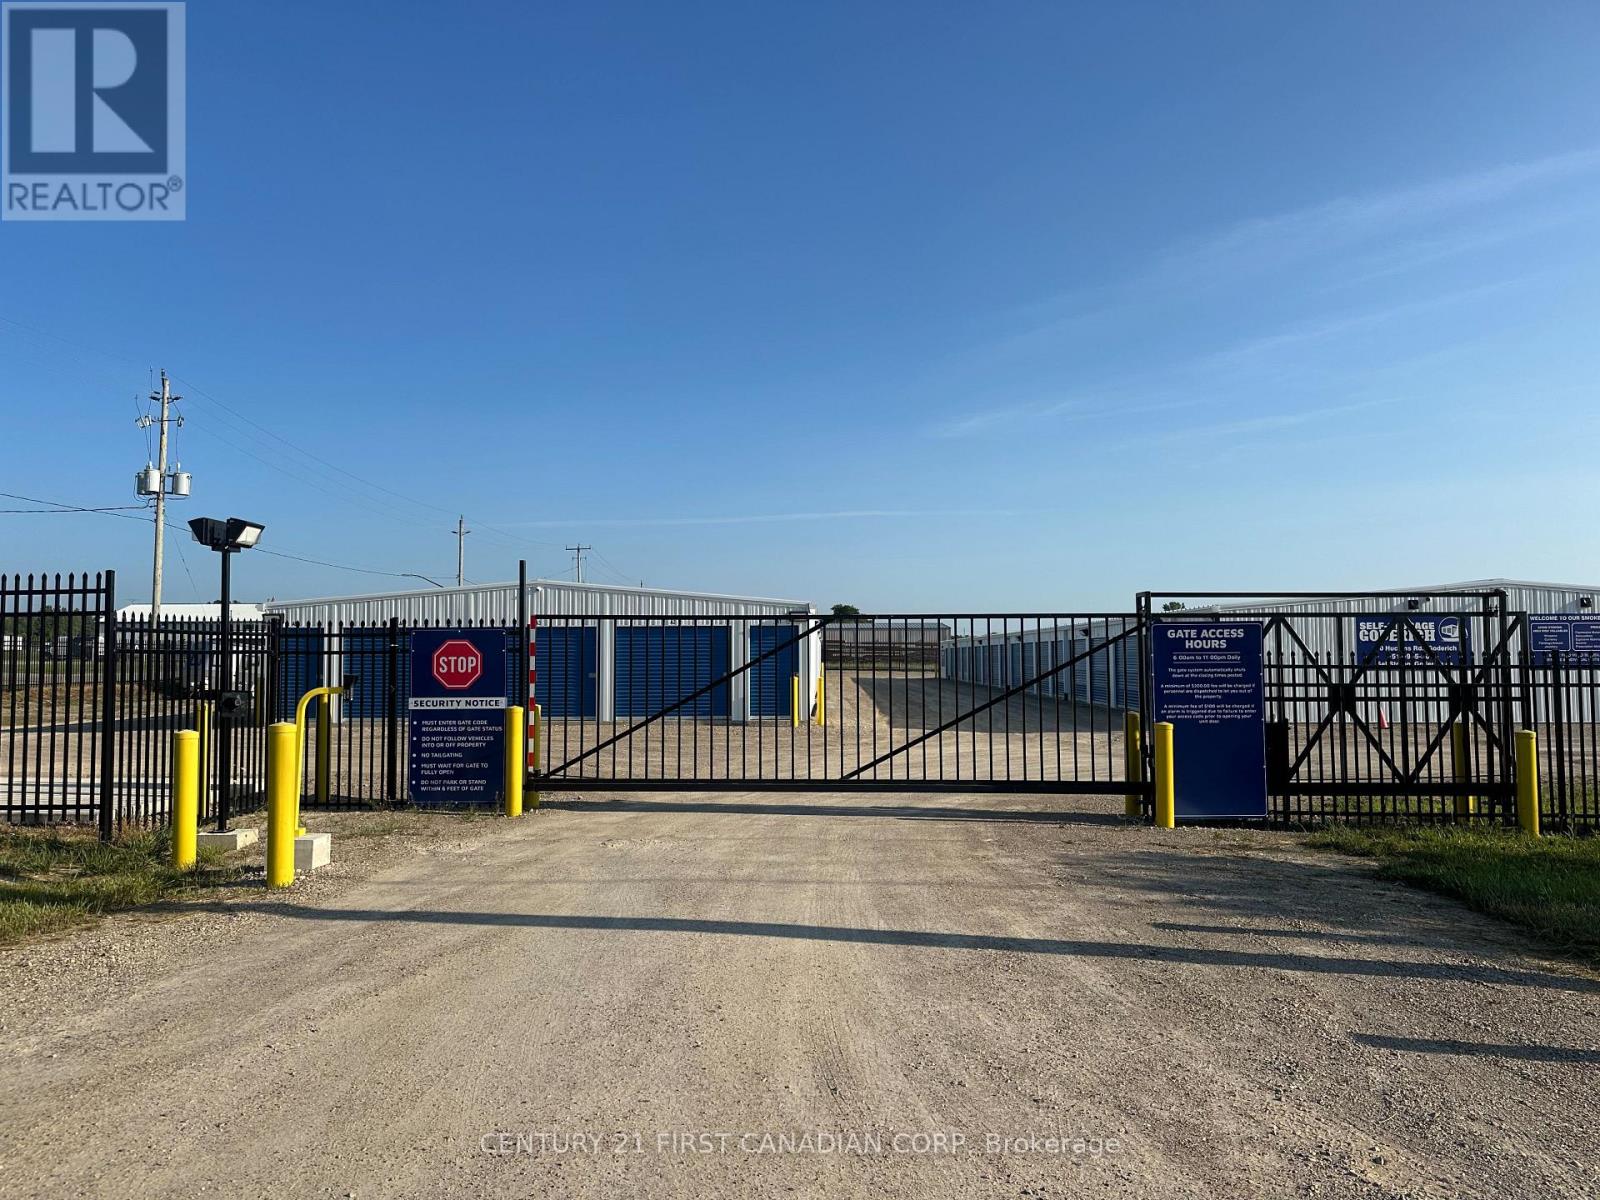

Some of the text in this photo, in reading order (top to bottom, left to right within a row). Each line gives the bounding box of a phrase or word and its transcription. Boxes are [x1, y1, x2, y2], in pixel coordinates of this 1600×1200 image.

[1167, 629, 1244, 638] GATE ACCESS
[1185, 640, 1227, 649] HOURS
[440, 656, 477, 673] STOP
